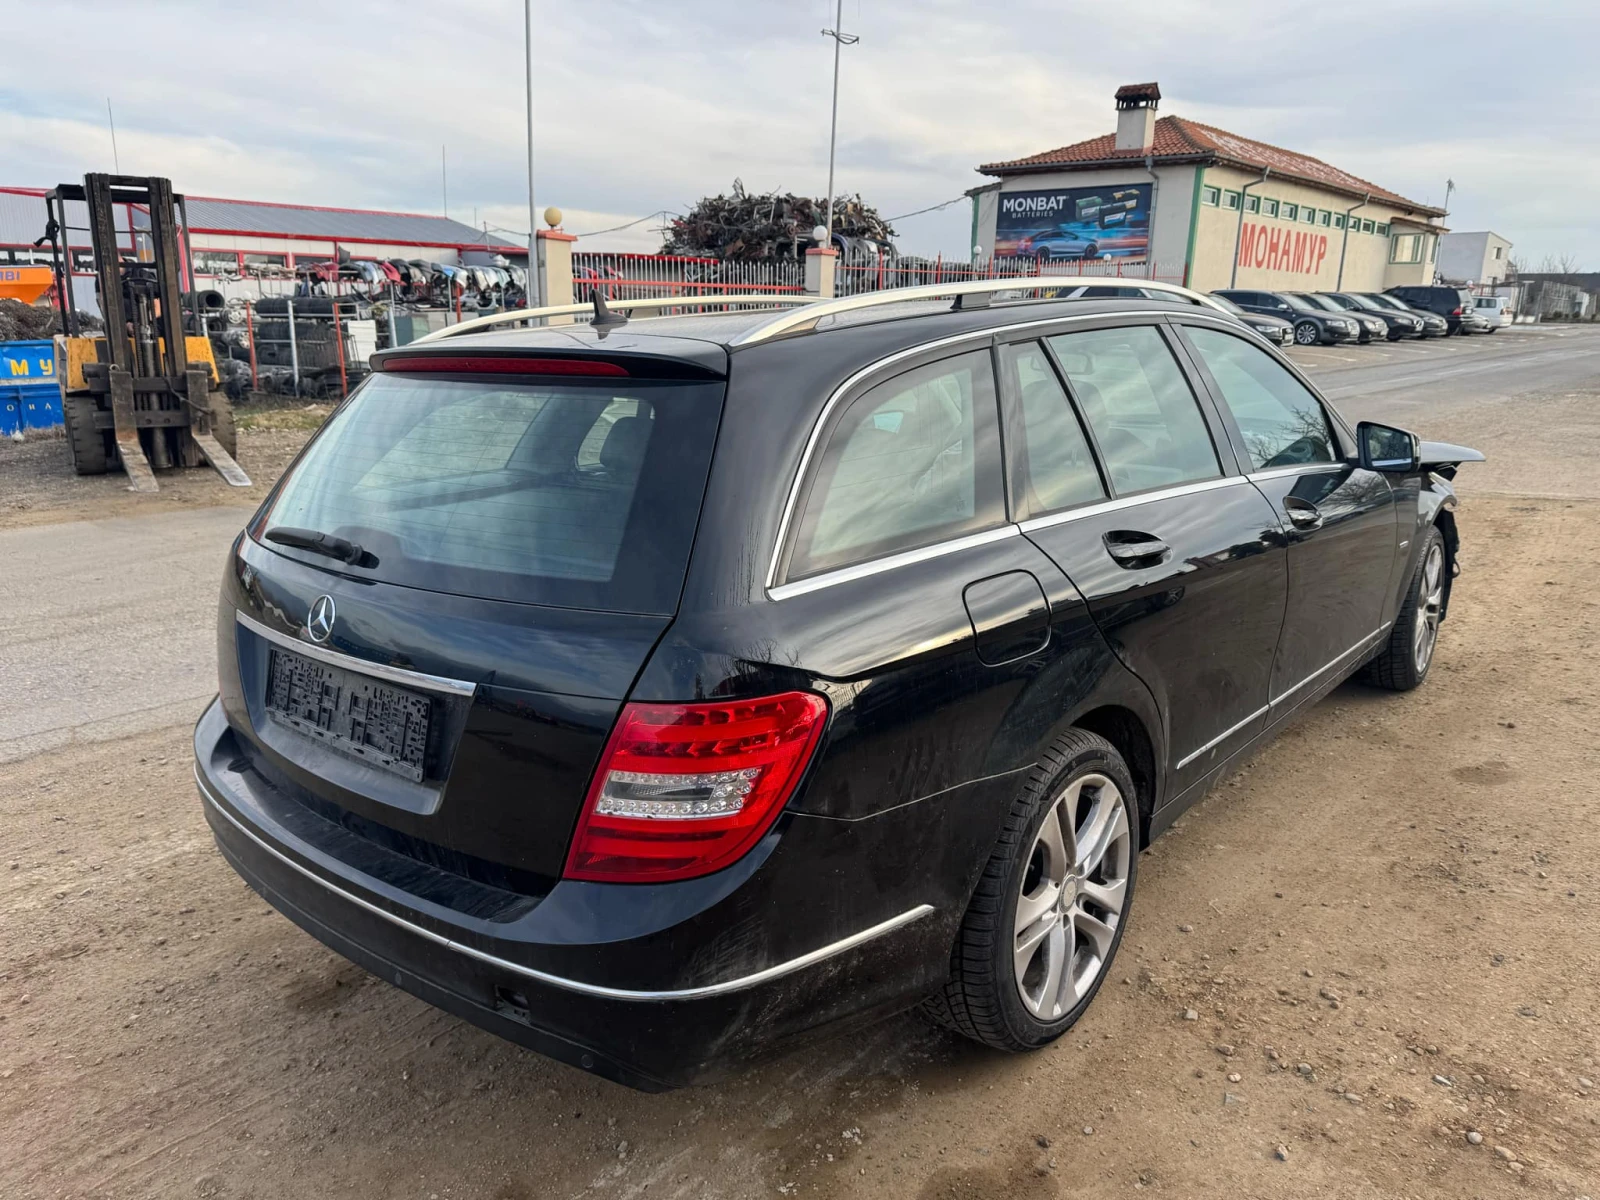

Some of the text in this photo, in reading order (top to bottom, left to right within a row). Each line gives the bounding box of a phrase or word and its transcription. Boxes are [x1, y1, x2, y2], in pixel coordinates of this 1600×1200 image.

[1003, 195, 1067, 213] MONBAT
[1012, 211, 1053, 219] BATTERIES
[1238, 222, 1327, 275] МОНАМУР
